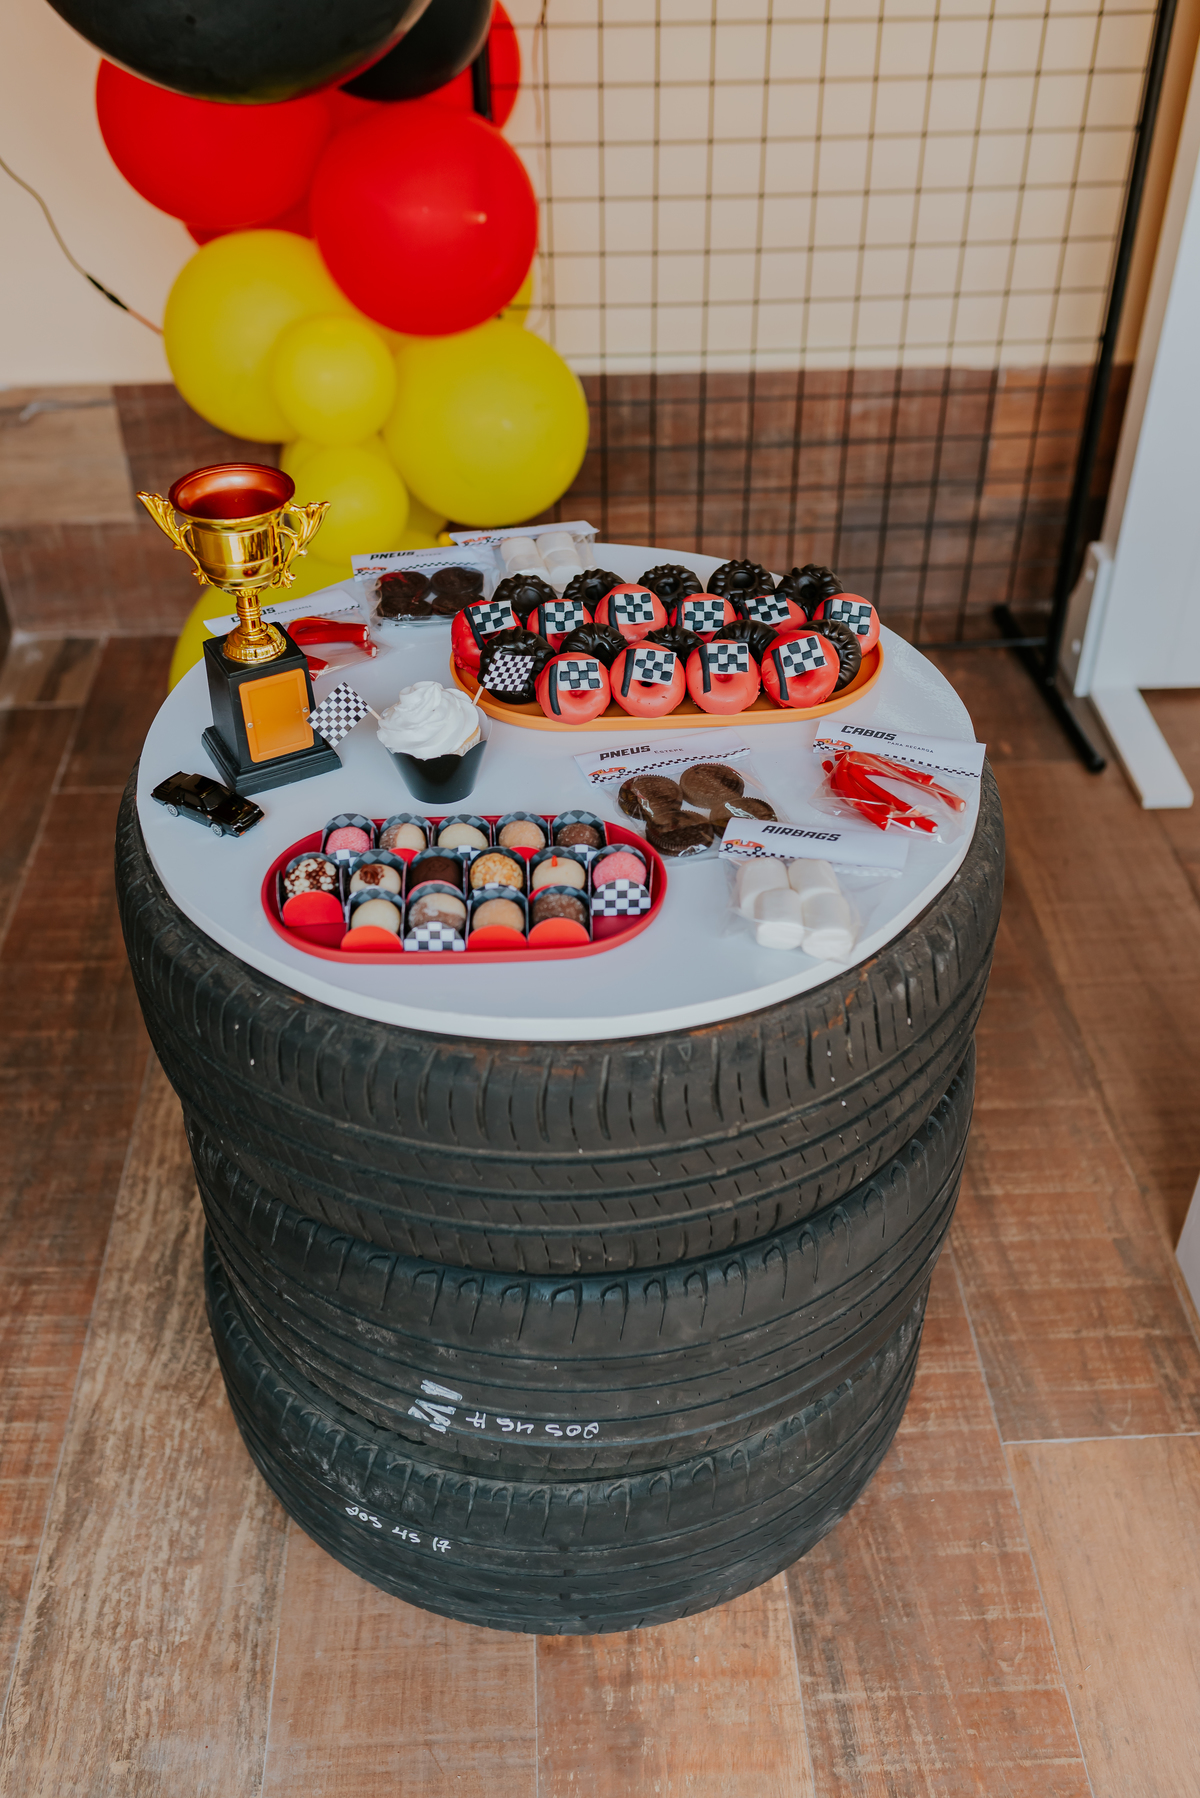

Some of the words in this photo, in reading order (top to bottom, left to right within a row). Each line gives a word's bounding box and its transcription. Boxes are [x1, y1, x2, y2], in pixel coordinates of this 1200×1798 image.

[370, 551, 415, 560] PNEUS
[840, 725, 898, 741] CABOS
[599, 745, 651, 761] PNEUS
[653, 747, 685, 755] ESTEPE
[905, 744, 934, 754] RECARGA
[761, 825, 842, 842] AIRBAGS
[344, 1506, 383, 1529] 205
[391, 1526, 422, 1544] 45
[432, 1537, 452, 1554] 17
